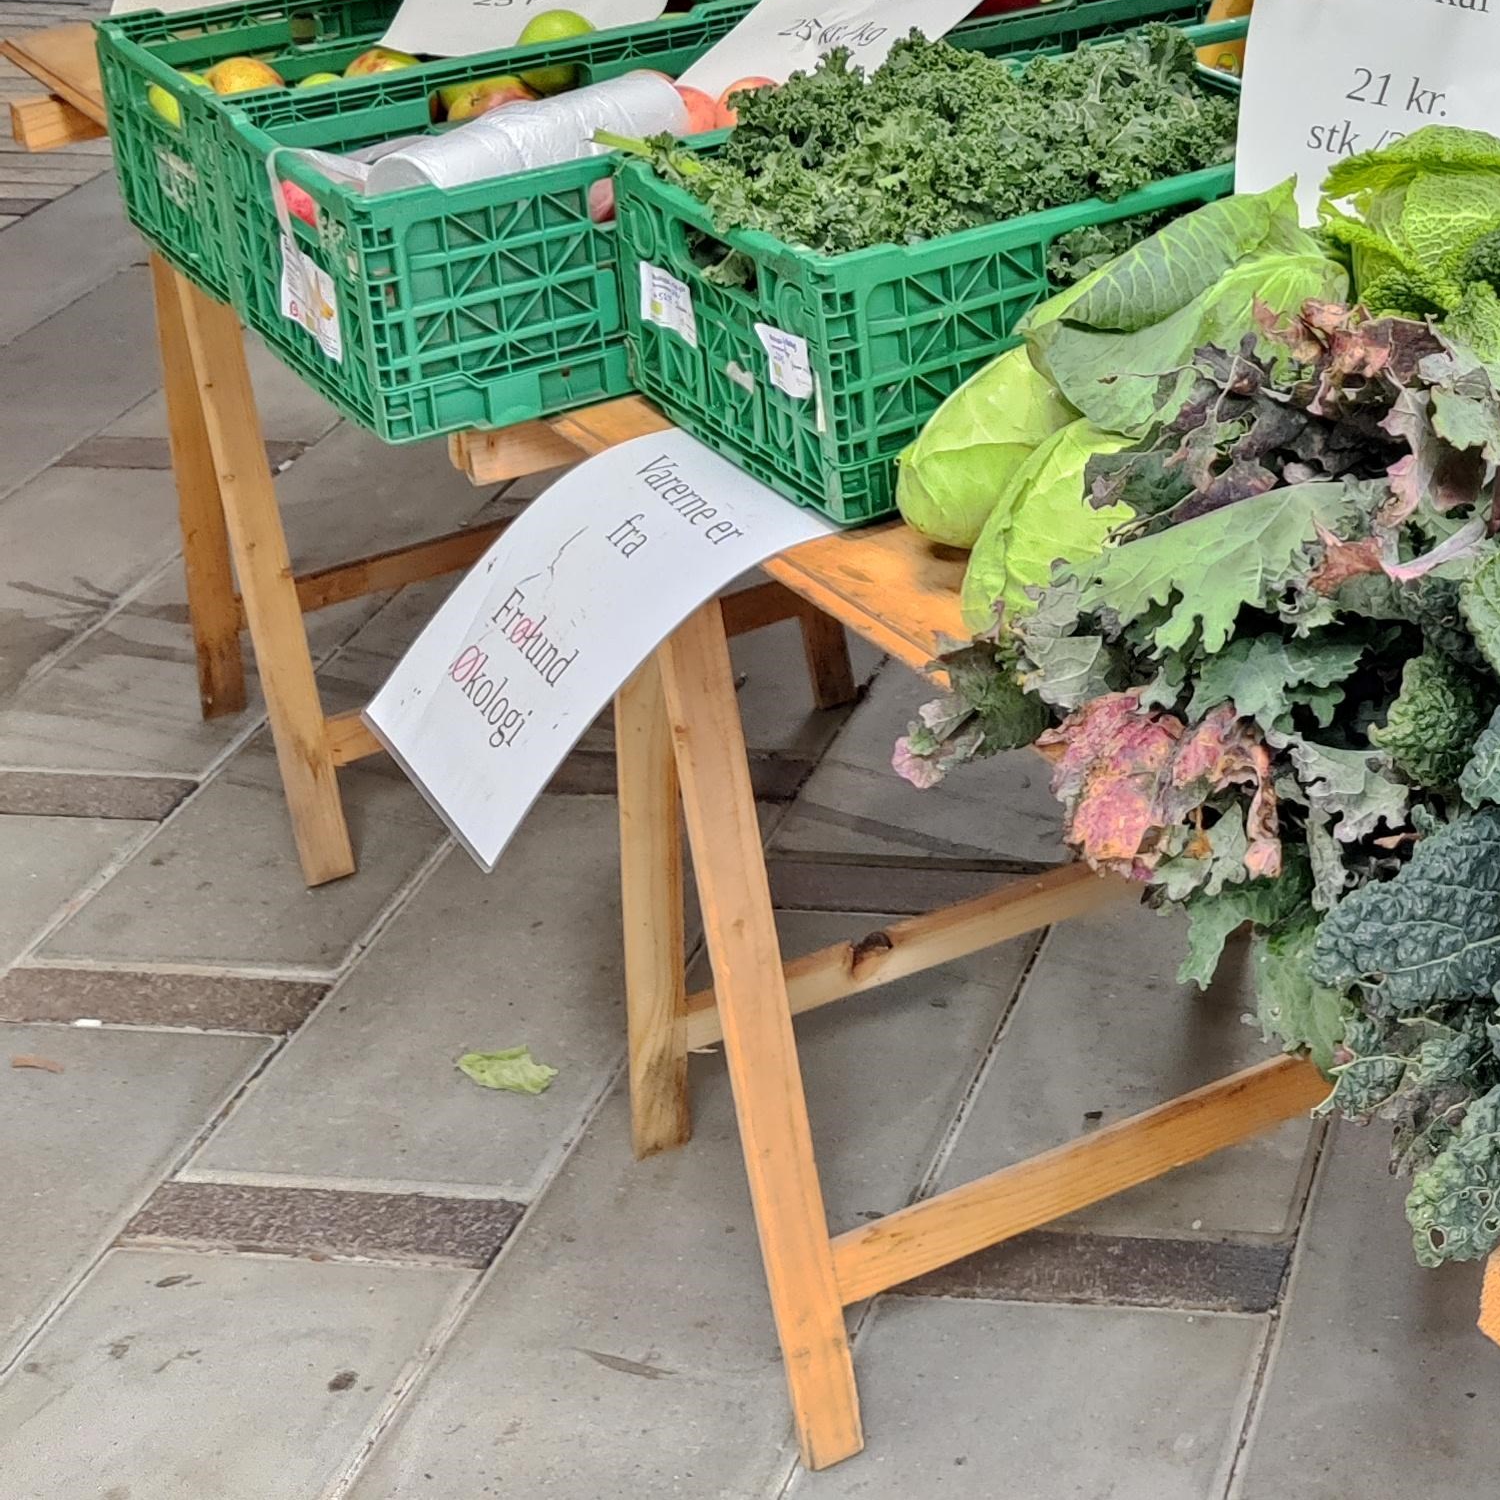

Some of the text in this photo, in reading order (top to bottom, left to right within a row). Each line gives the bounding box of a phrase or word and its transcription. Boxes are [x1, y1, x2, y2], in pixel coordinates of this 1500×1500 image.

[777, 18, 889, 47] 25 kr./kg
[1345, 66, 1447, 117] 21 kr.
[605, 512, 649, 559] fra
[636, 454, 745, 546] Varerne er
[491, 587, 581, 688] Frølund
[447, 645, 534, 749] Økologi
